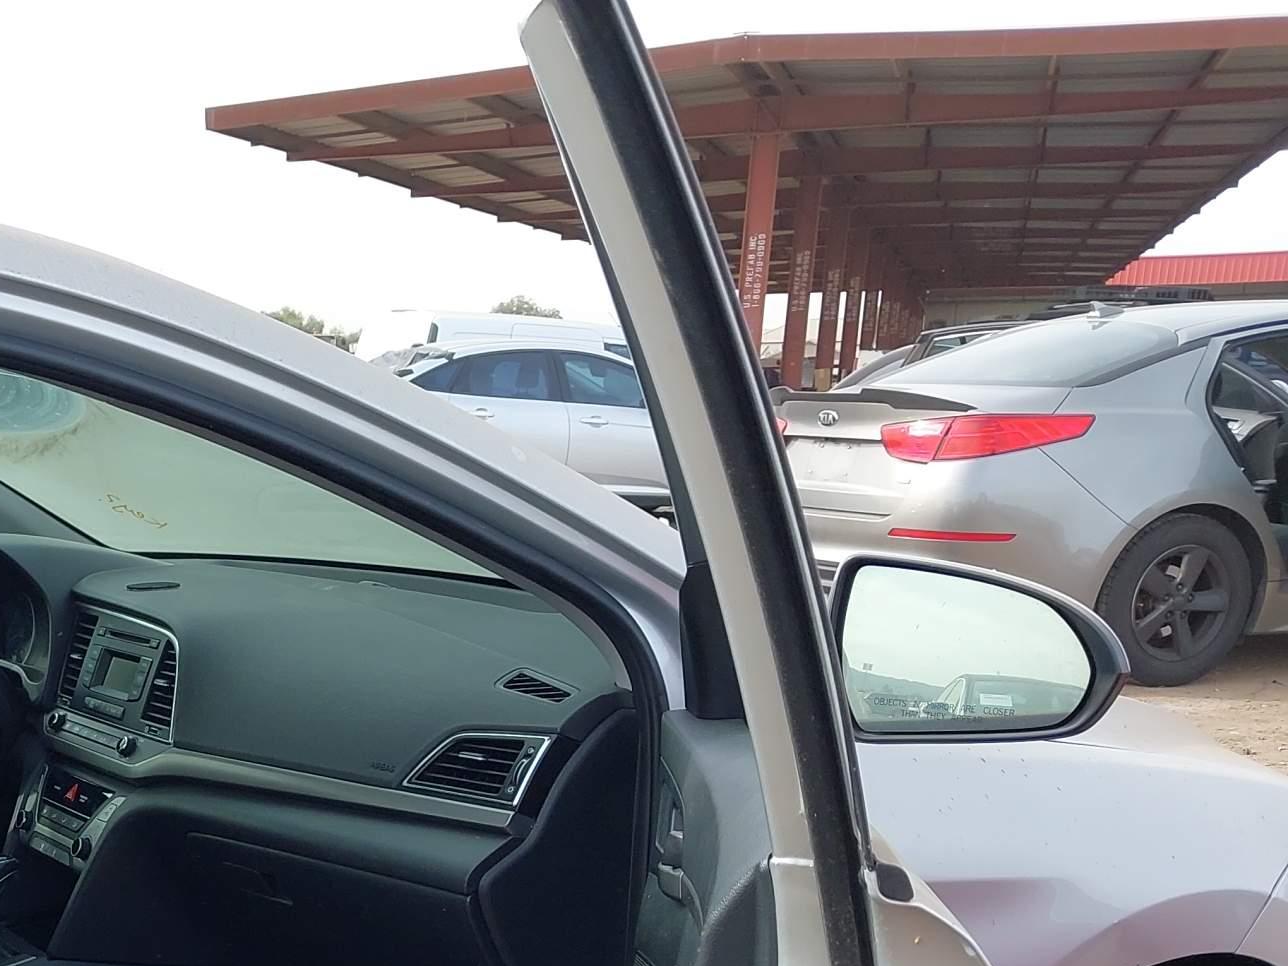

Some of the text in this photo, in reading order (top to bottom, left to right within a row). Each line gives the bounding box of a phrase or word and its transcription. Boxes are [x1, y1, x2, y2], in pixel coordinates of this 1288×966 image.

[744, 254, 756, 288] PREFAB
[873, 697, 907, 708] OBJECTS
[960, 703, 977, 714] ARE
[983, 706, 1016, 717] CLOSER
